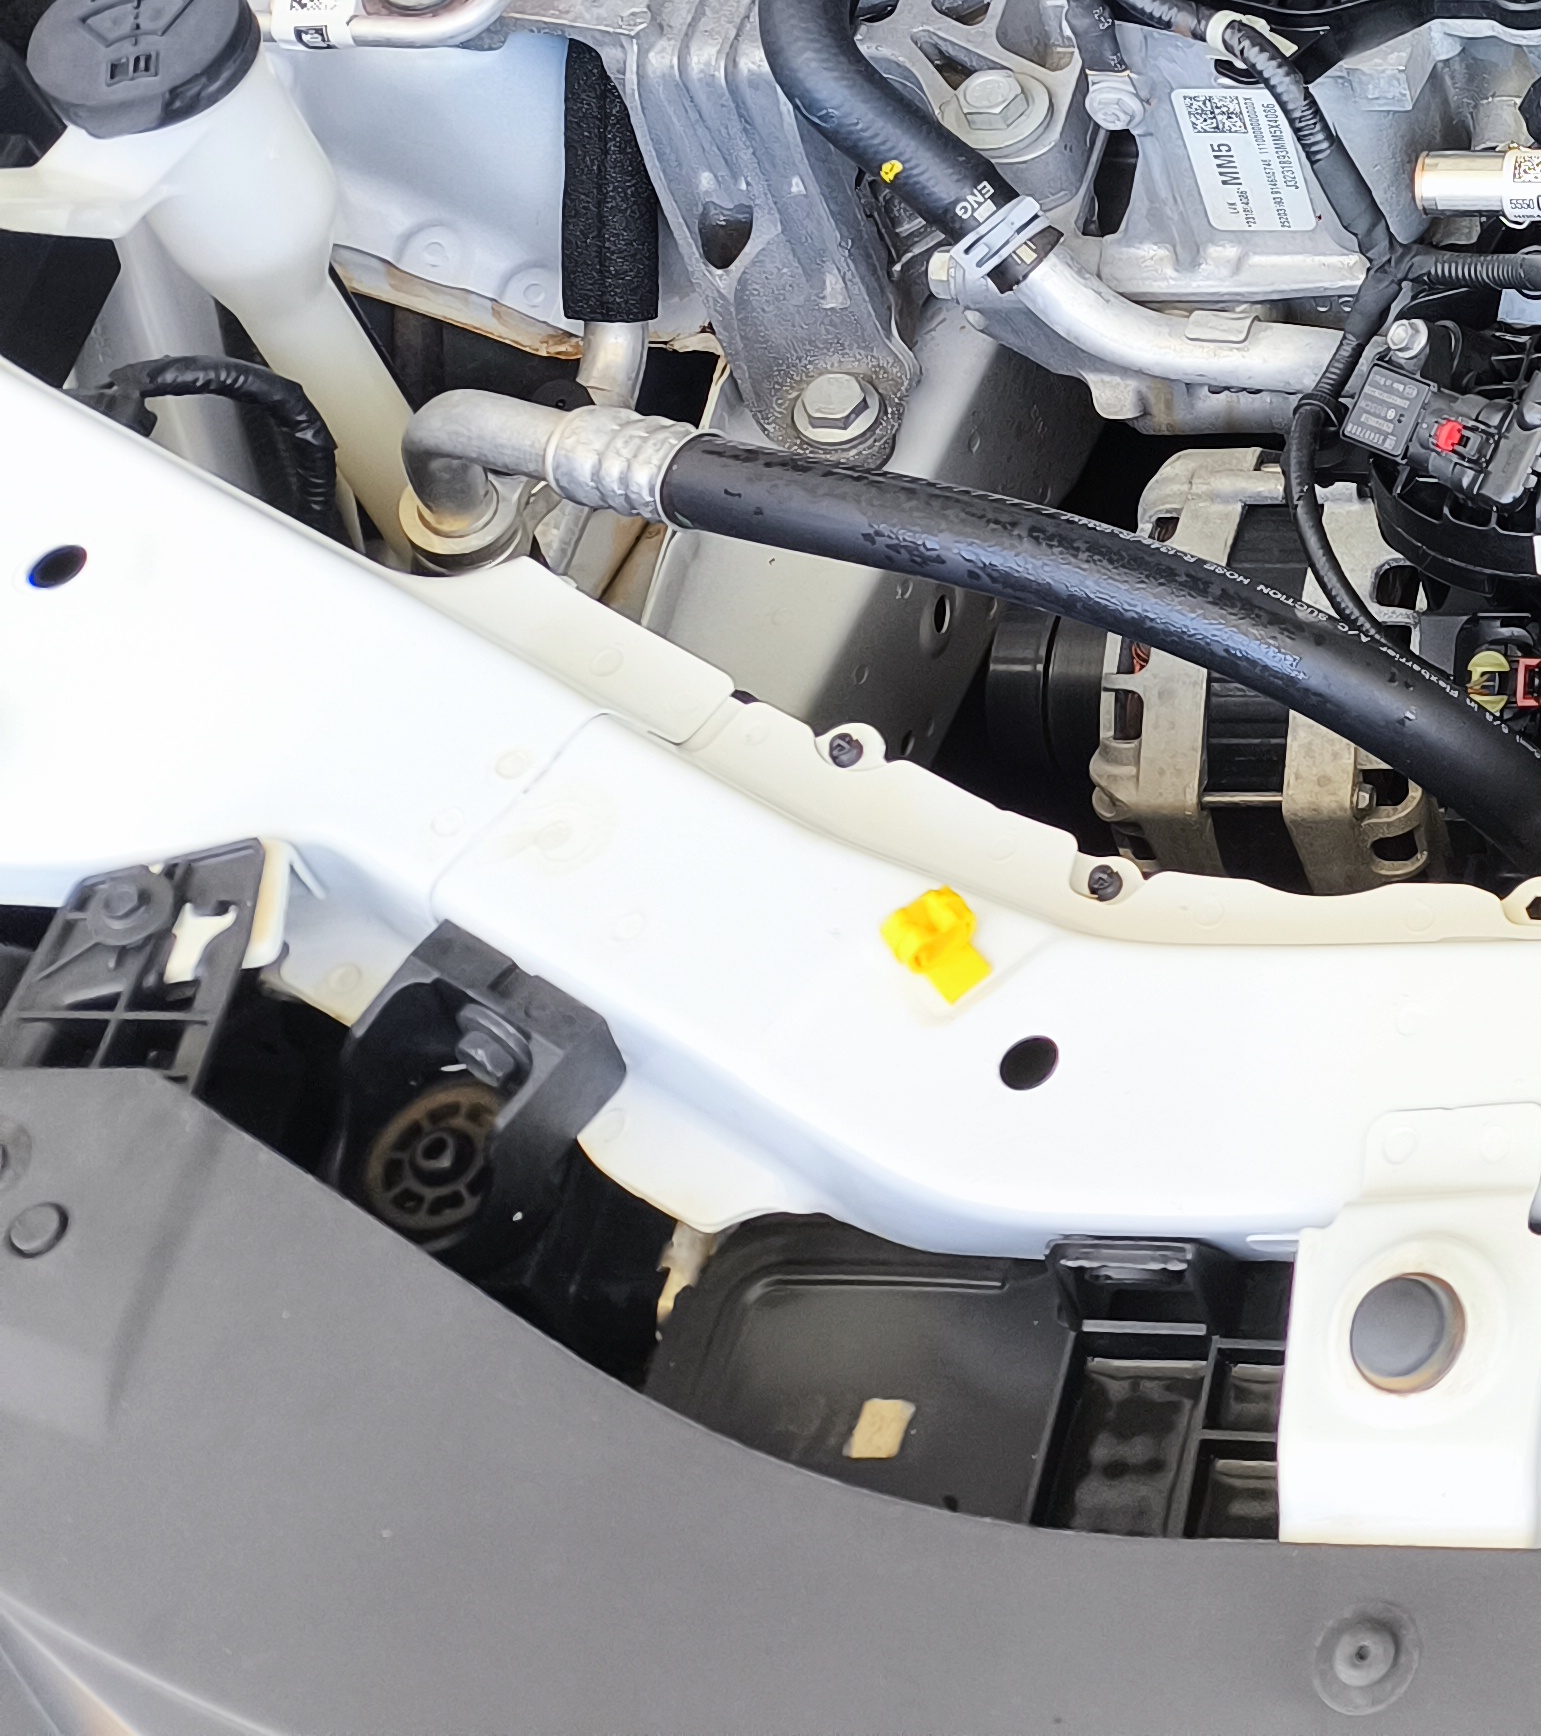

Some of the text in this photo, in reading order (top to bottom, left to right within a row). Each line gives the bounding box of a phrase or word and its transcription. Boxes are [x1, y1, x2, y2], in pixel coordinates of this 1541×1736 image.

[1210, 143, 1243, 186] MM5
[955, 180, 995, 219] ENG
[1203, 562, 1251, 585] HOSE
[1257, 584, 1328, 621] SUCTION
